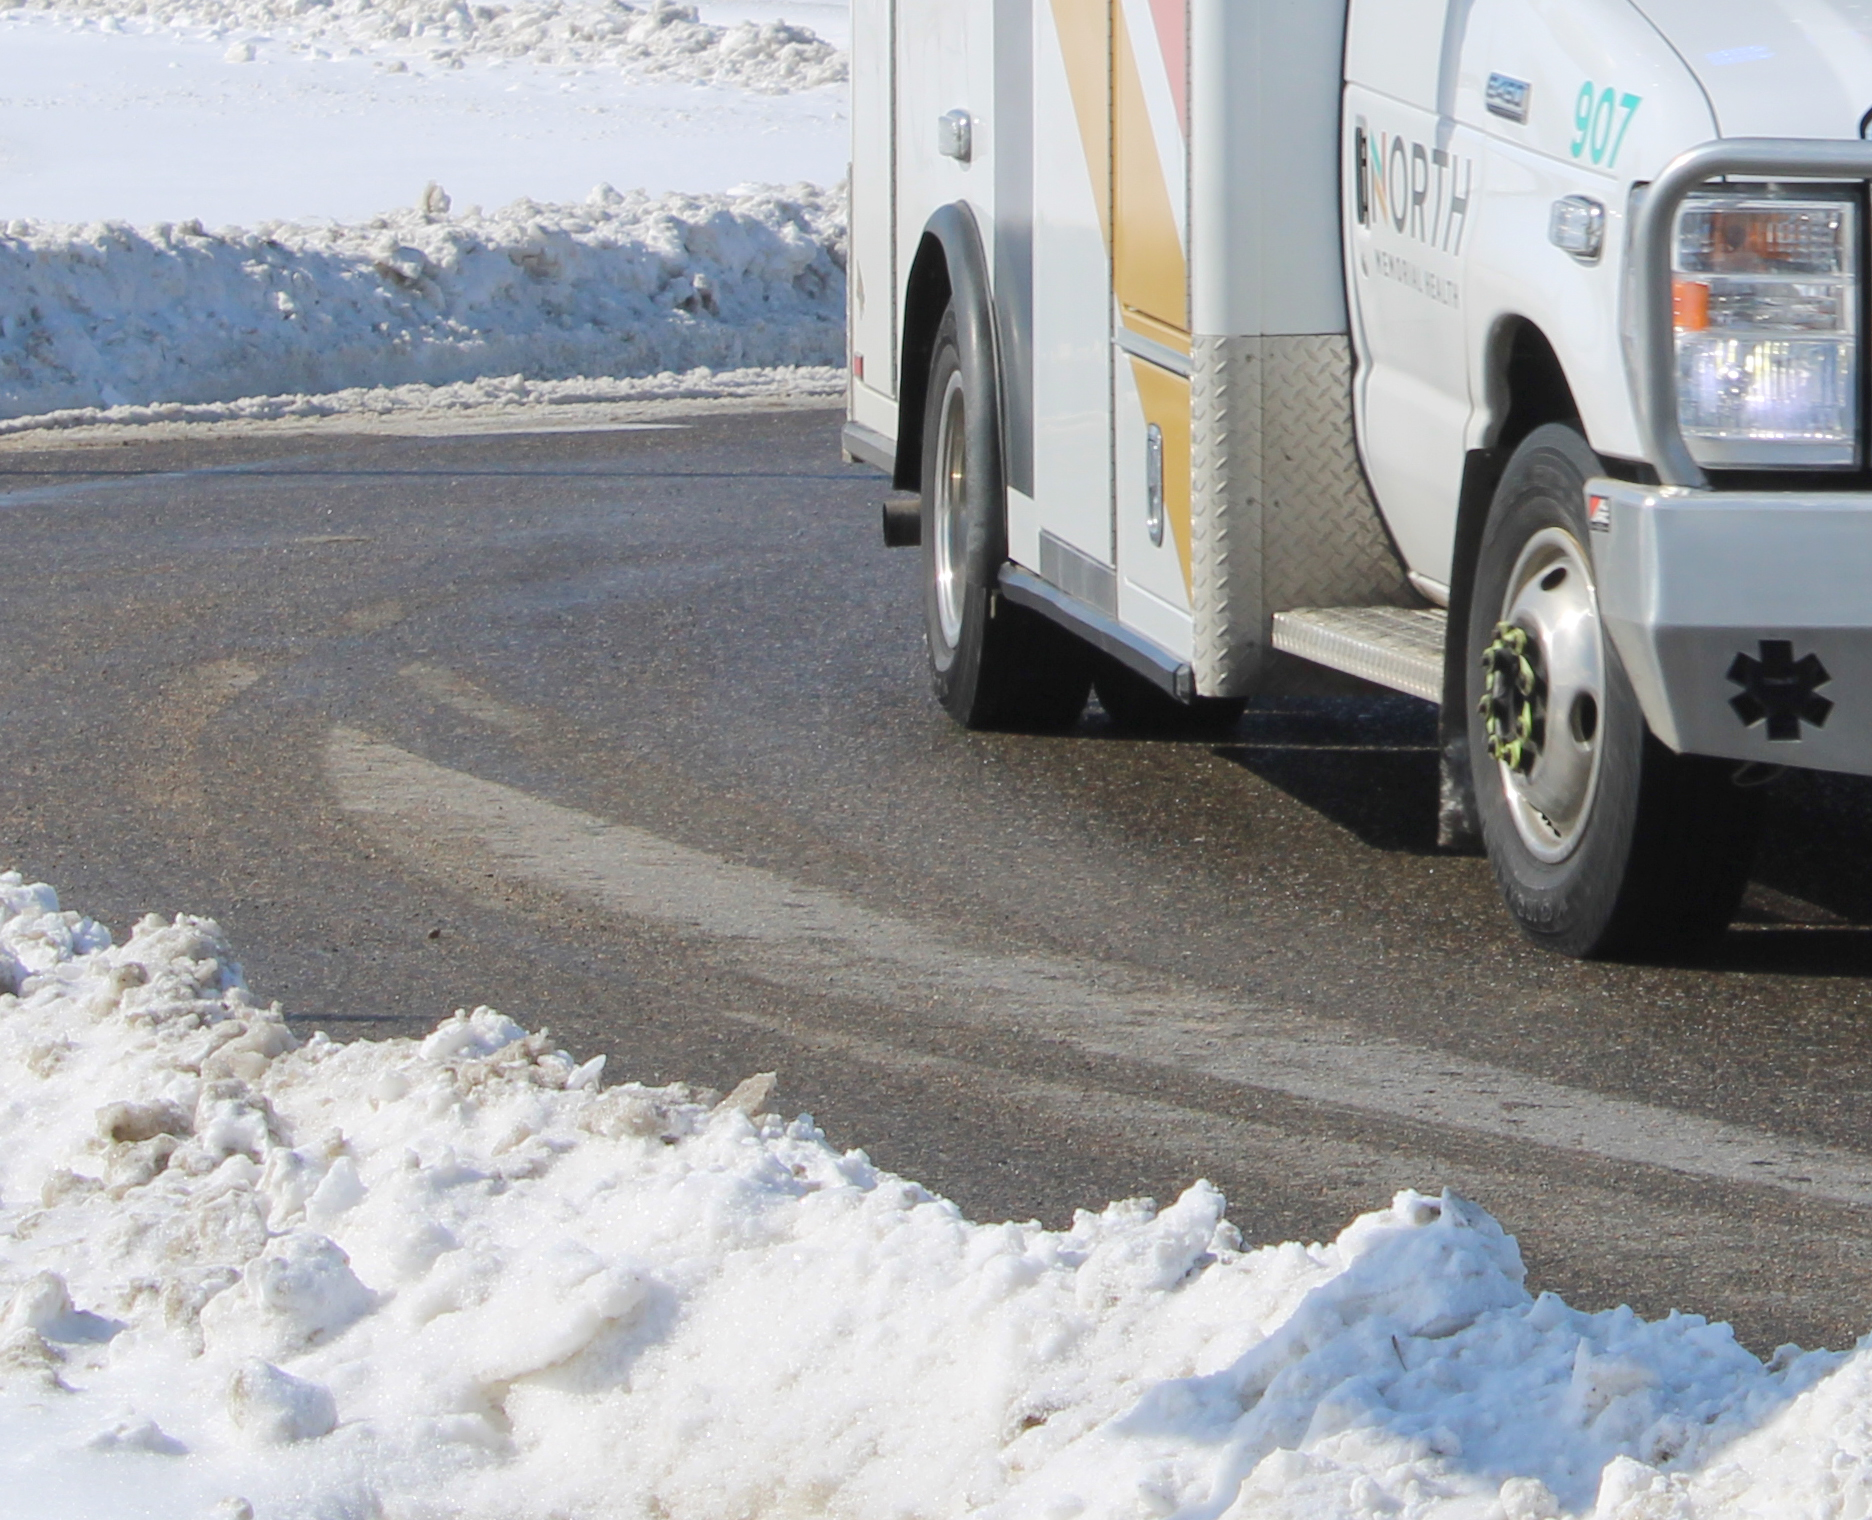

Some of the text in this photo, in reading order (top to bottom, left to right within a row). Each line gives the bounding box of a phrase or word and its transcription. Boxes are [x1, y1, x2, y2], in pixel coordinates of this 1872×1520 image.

[1571, 81, 1642, 168] 907
[1367, 130, 1472, 256] NORTH
[1423, 270, 1459, 310] HEALTH
